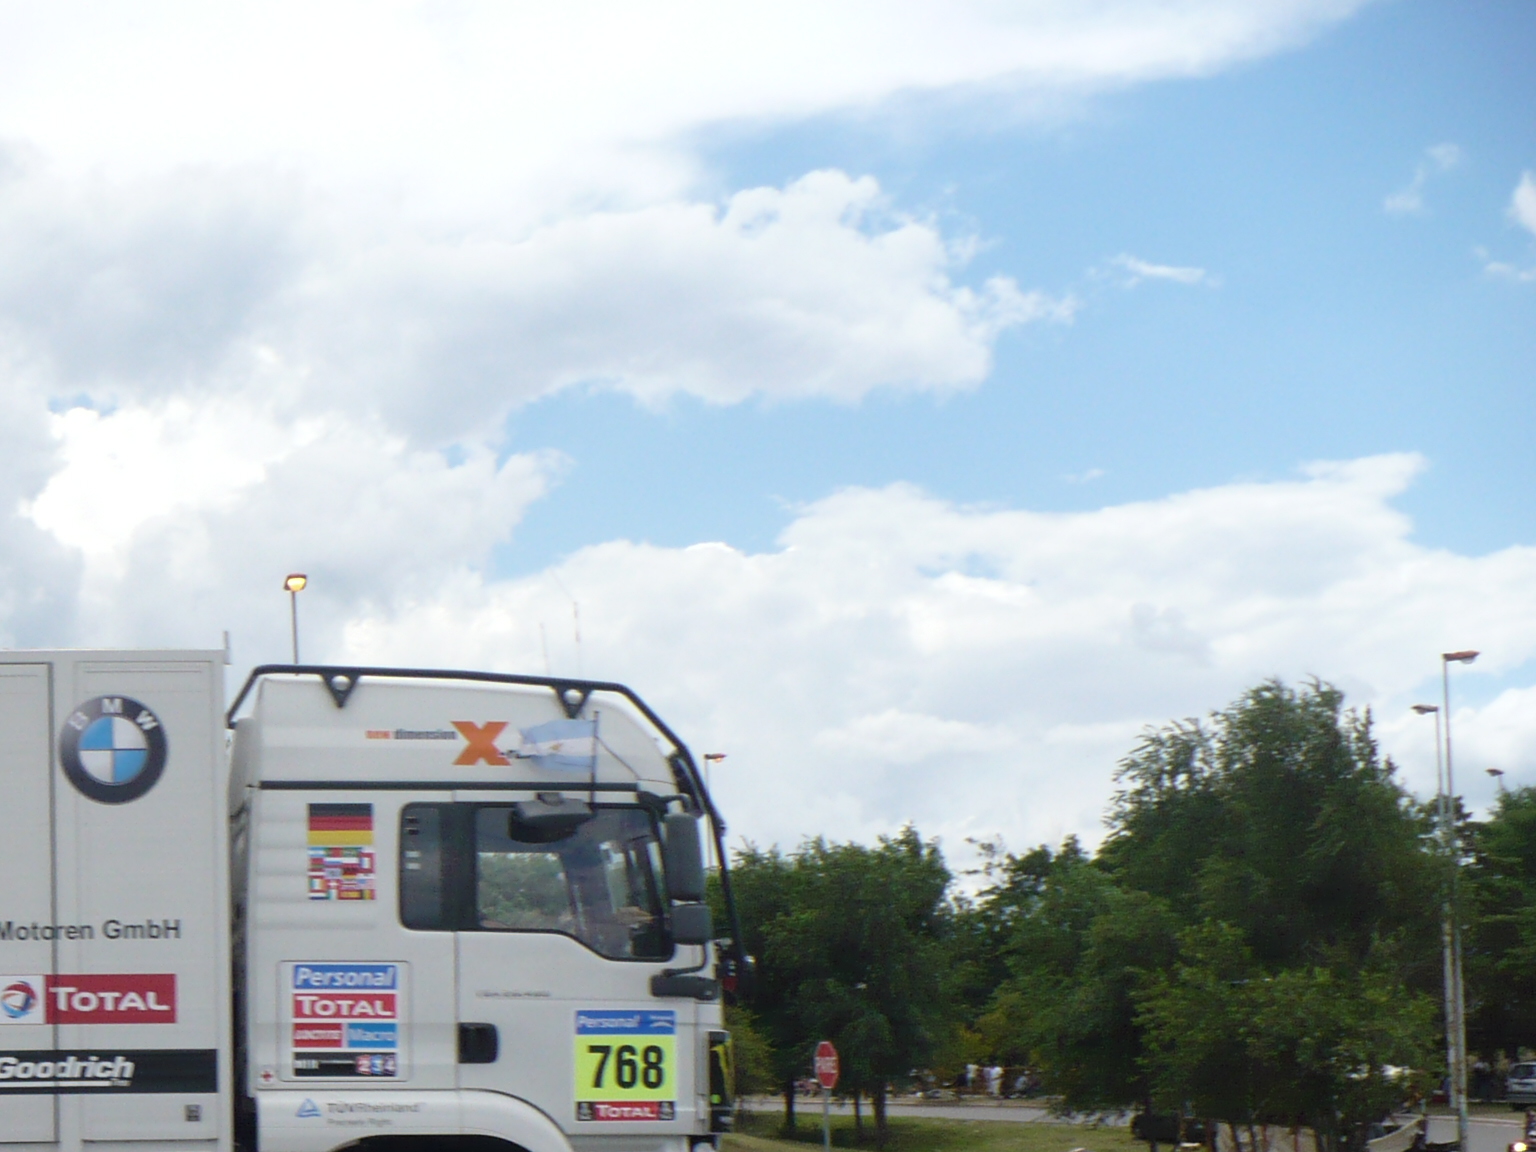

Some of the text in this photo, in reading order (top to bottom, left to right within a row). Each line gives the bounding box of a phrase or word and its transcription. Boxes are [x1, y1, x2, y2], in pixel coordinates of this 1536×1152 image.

[68, 697, 159, 731] BMW
[450, 721, 512, 766] X
[102, 919, 181, 939] GmbH
[296, 967, 396, 987] Personal
[49, 986, 170, 1012] TOTAL
[295, 995, 394, 1016] TOTAL
[588, 1045, 664, 1089] 768
[595, 1104, 656, 1118] TOTAL
